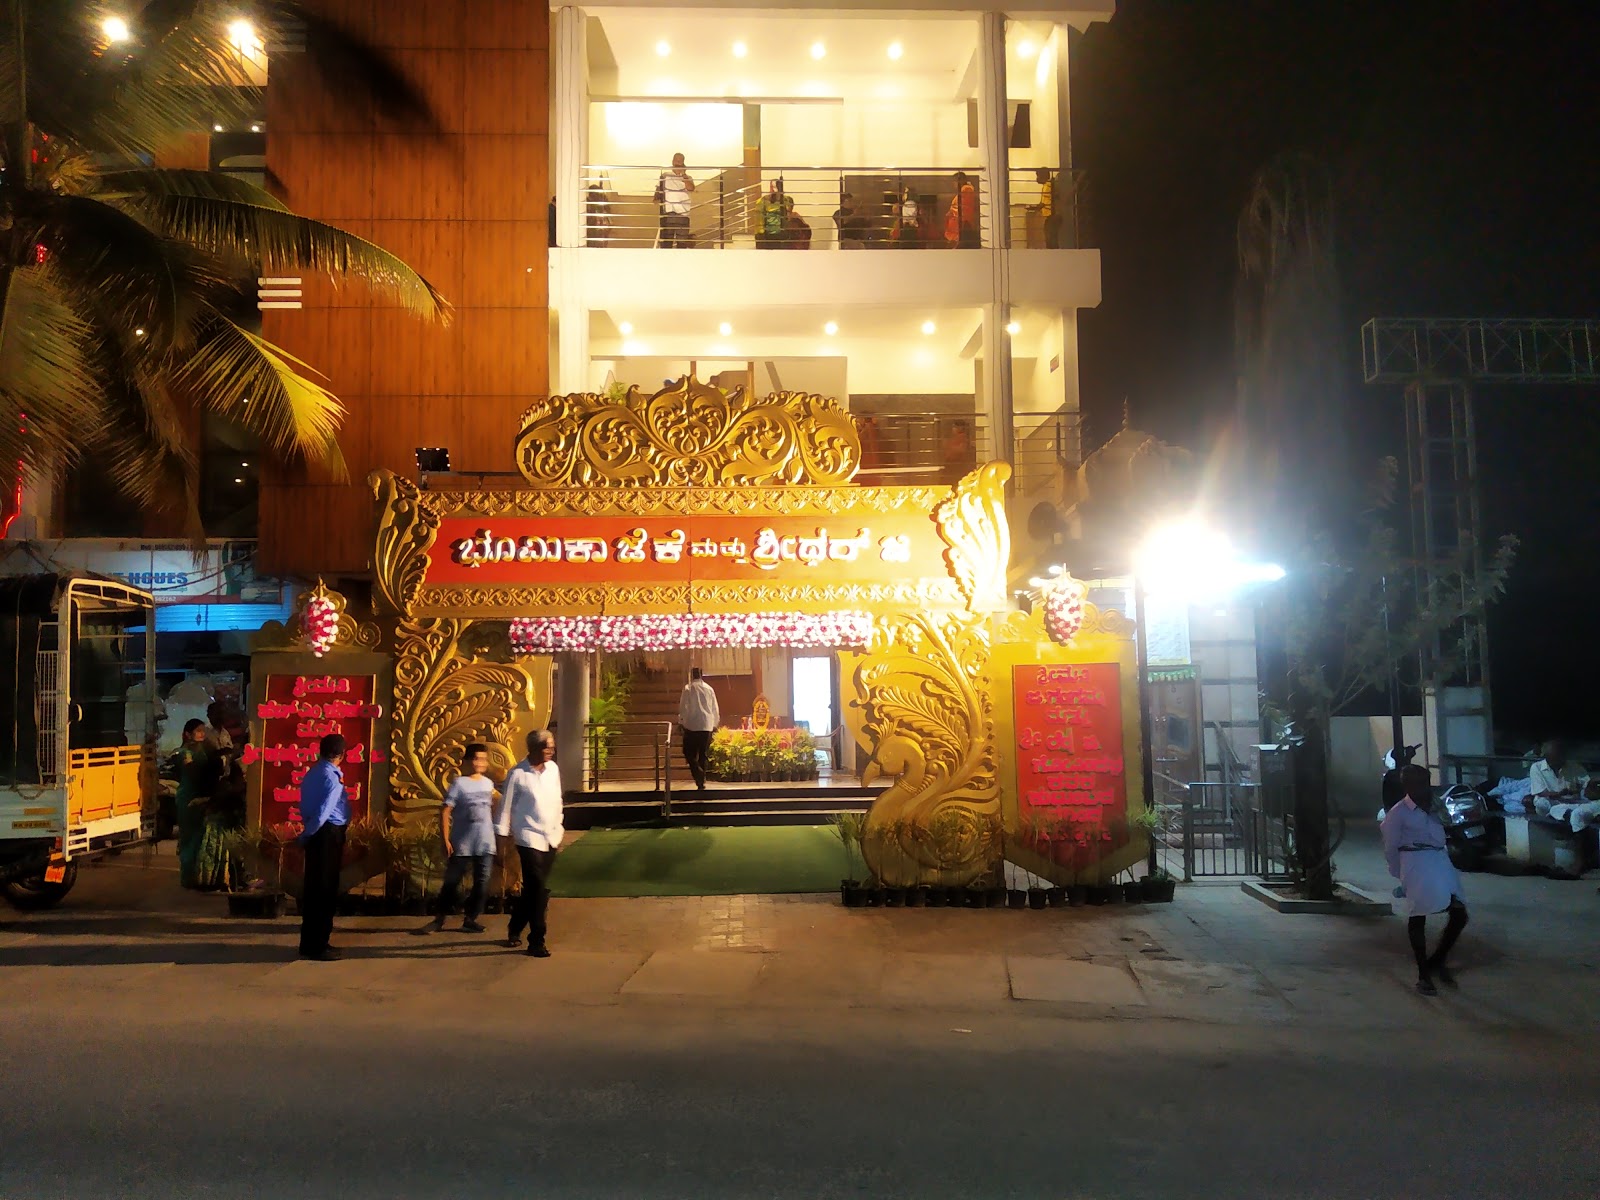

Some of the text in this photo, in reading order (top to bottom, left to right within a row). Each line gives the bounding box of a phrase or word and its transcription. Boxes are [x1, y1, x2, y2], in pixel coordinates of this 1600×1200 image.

[458, 528, 608, 568] ಭೂಮಿಕಾ
[690, 537, 750, 564] ಮತ್ತು
[752, 527, 870, 570] ಶ್ರೀಧರ್
[128, 572, 188, 585] HOUES
